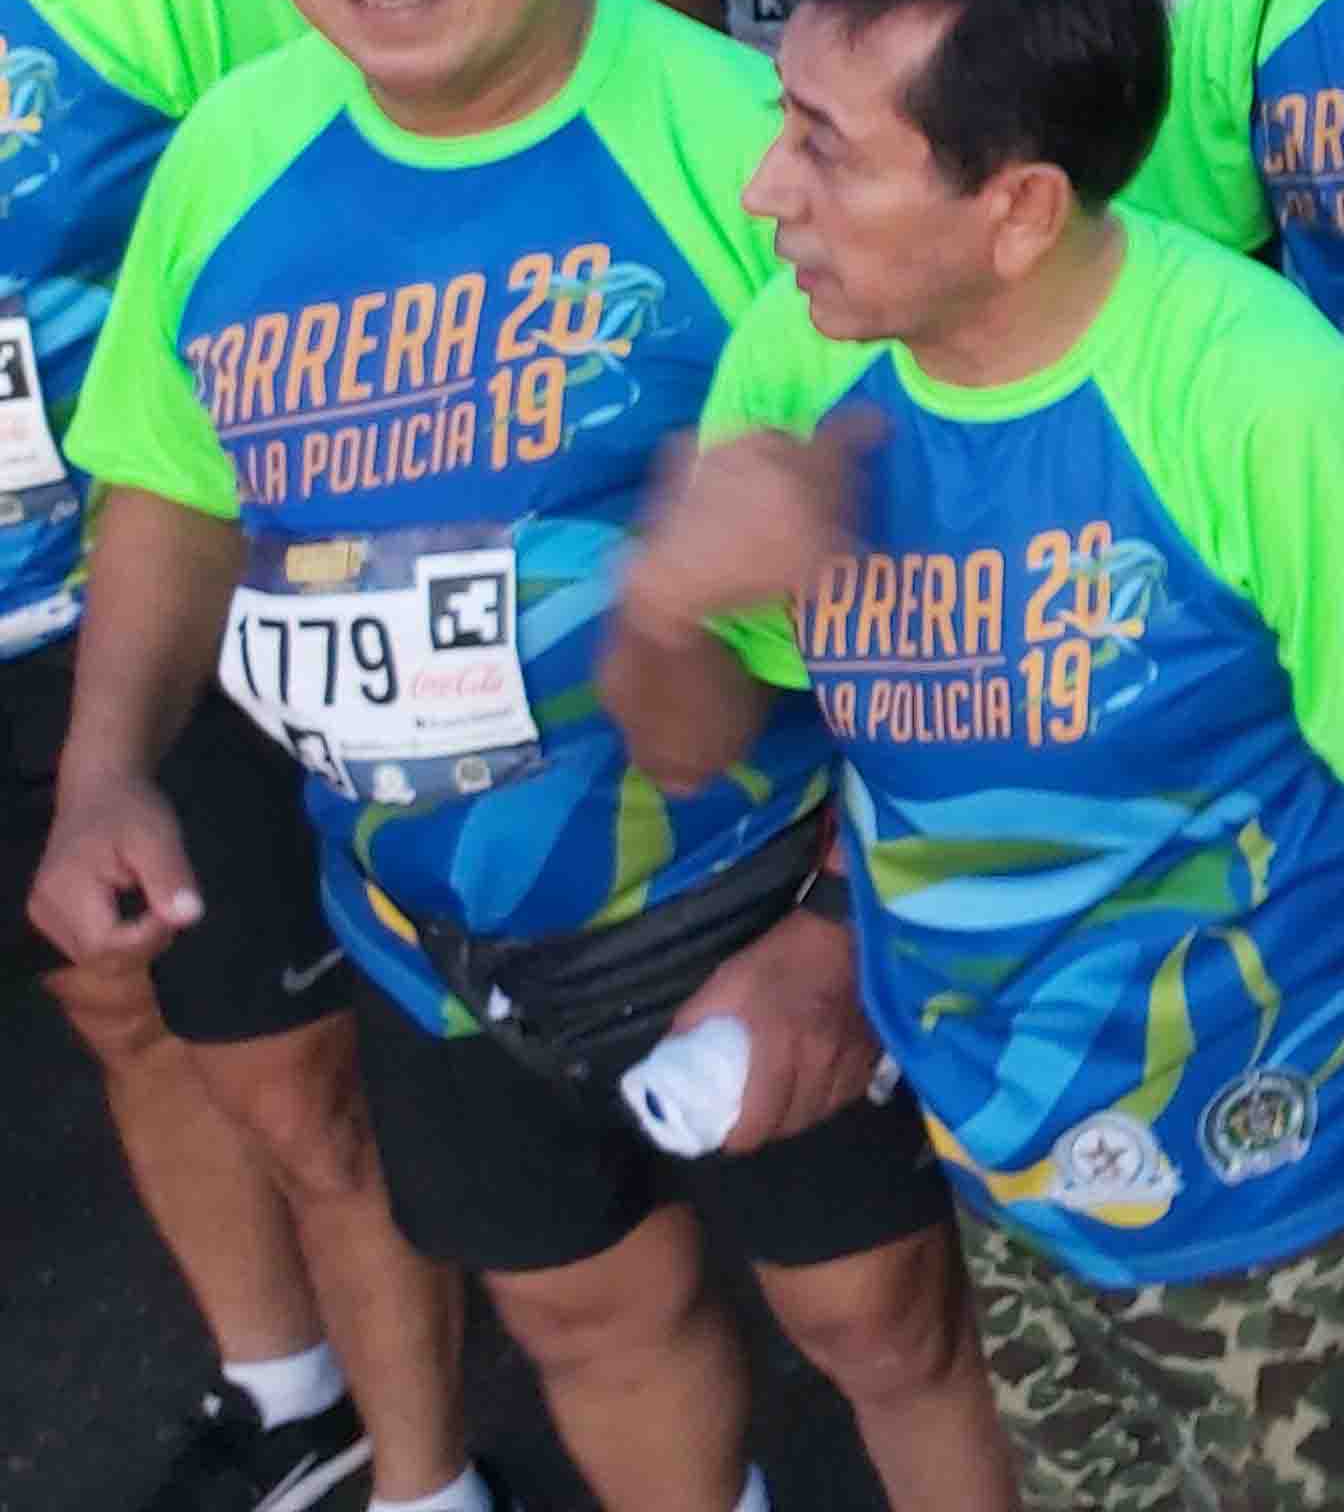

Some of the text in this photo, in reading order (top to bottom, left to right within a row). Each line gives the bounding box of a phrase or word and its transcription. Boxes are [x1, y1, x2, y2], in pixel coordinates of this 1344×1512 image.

[495, 242, 612, 362] 20
[302, 399, 475, 500] POLICÍA
[486, 356, 568, 472] 19
[1024, 520, 1114, 645] 20
[867, 664, 1011, 744] POLICÍA
[1018, 642, 1091, 748] 19
